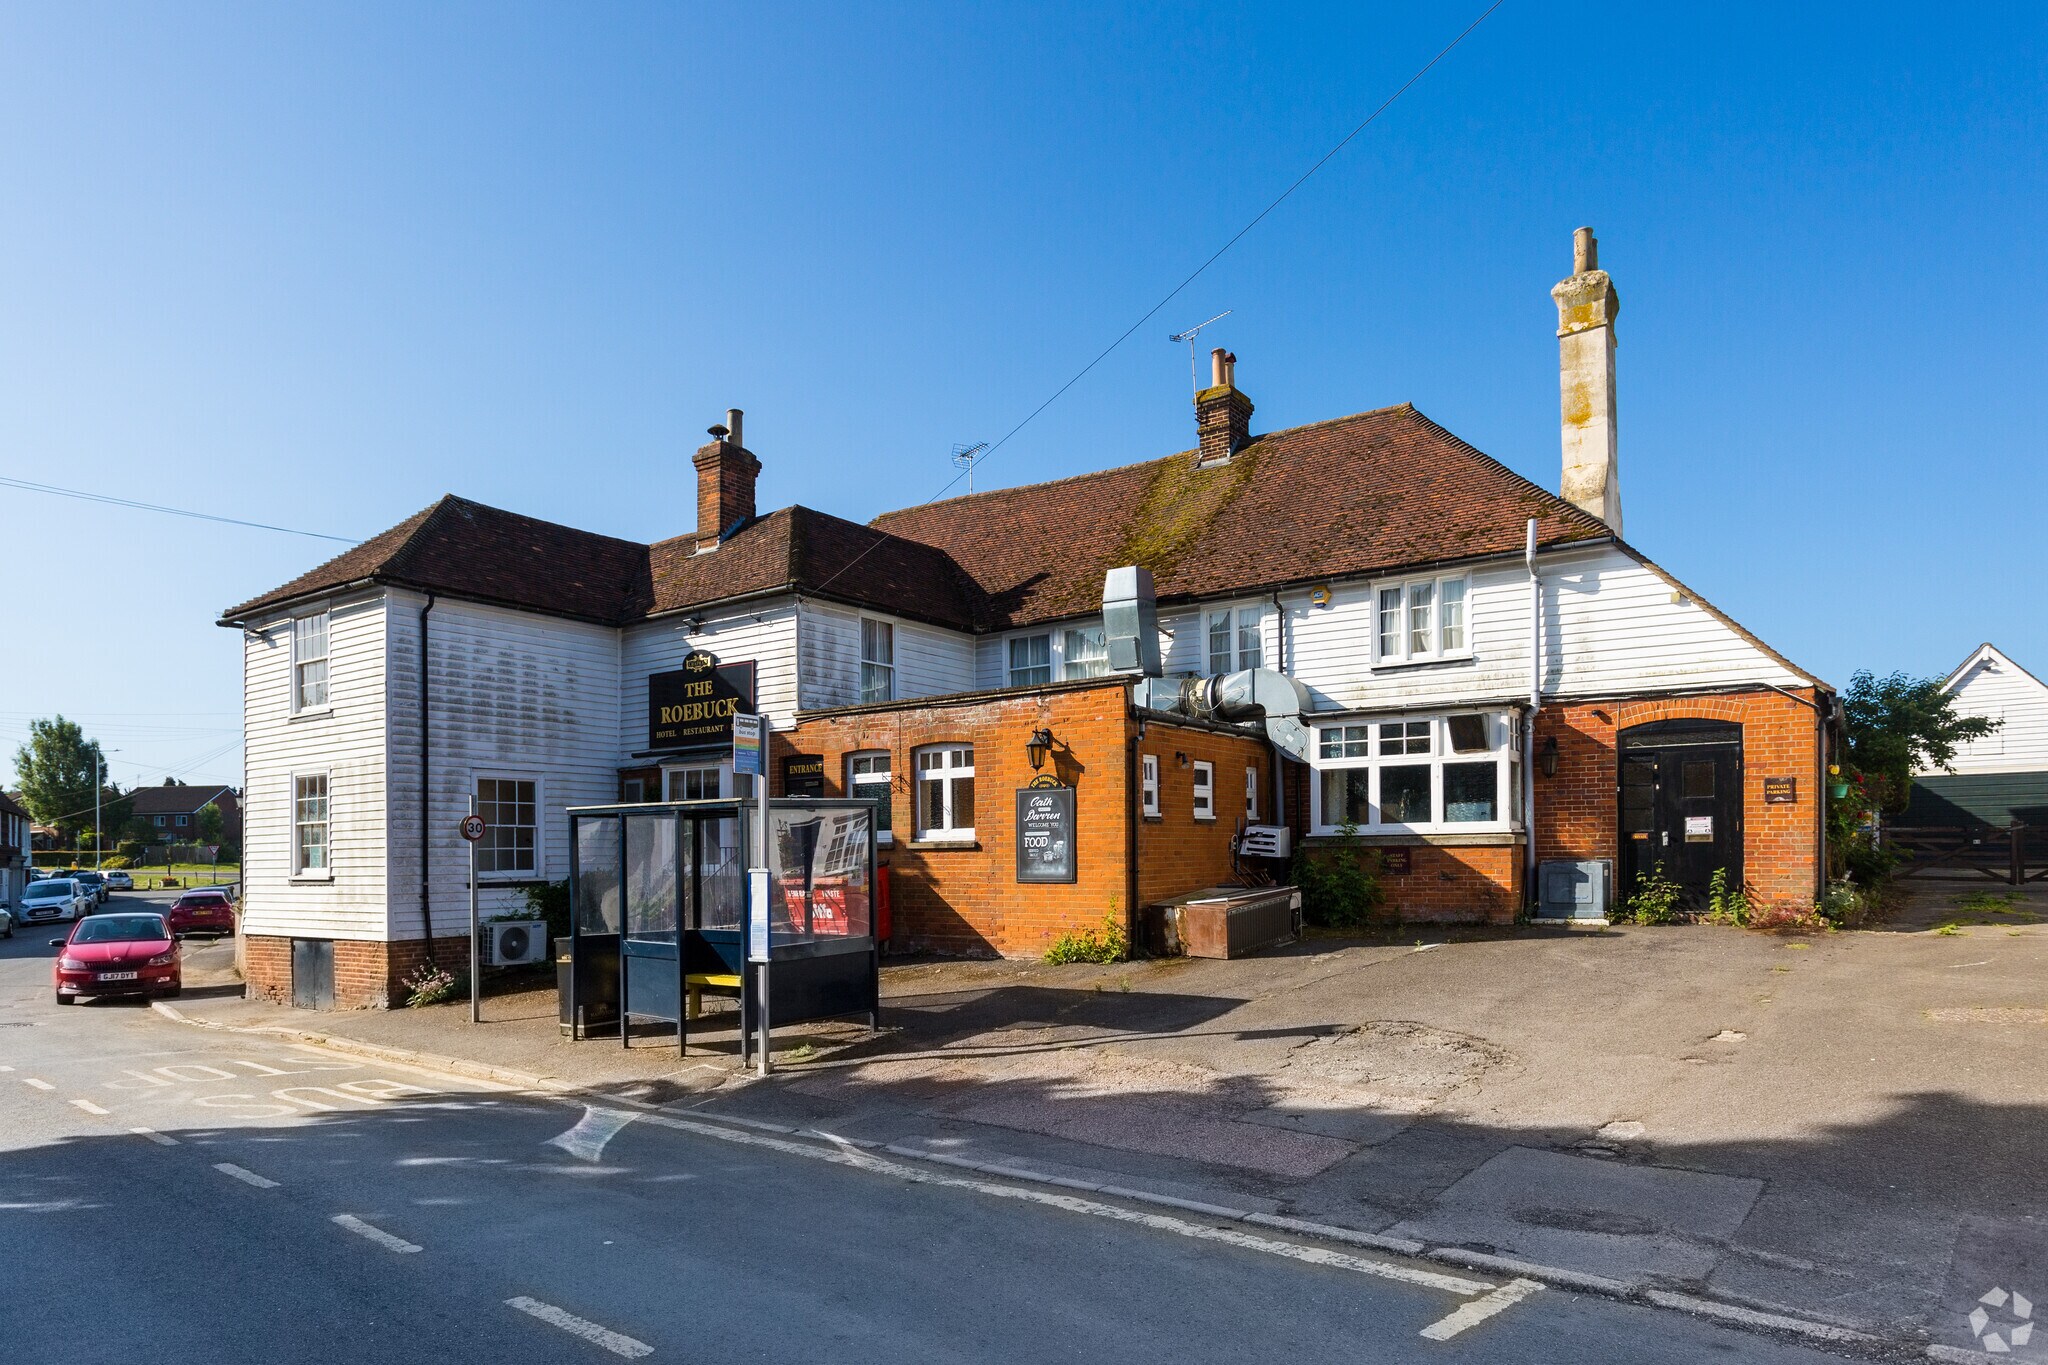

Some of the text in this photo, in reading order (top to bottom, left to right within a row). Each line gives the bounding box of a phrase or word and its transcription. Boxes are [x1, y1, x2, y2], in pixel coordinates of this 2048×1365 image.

[684, 680, 714, 698] THE
[660, 697, 739, 724] ROEBUCK
[656, 729, 677, 739] HOTEL
[683, 724, 724, 736] RESTAURANT
[789, 763, 822, 775] ENTRANCE
[1030, 796, 1053, 807] Cath
[1023, 809, 1061, 822] Darren
[468, 822, 483, 833] 30
[1024, 837, 1048, 848] FOOD
[102, 1056, 366, 1090] STOP
[194, 1079, 442, 1119] BUS
